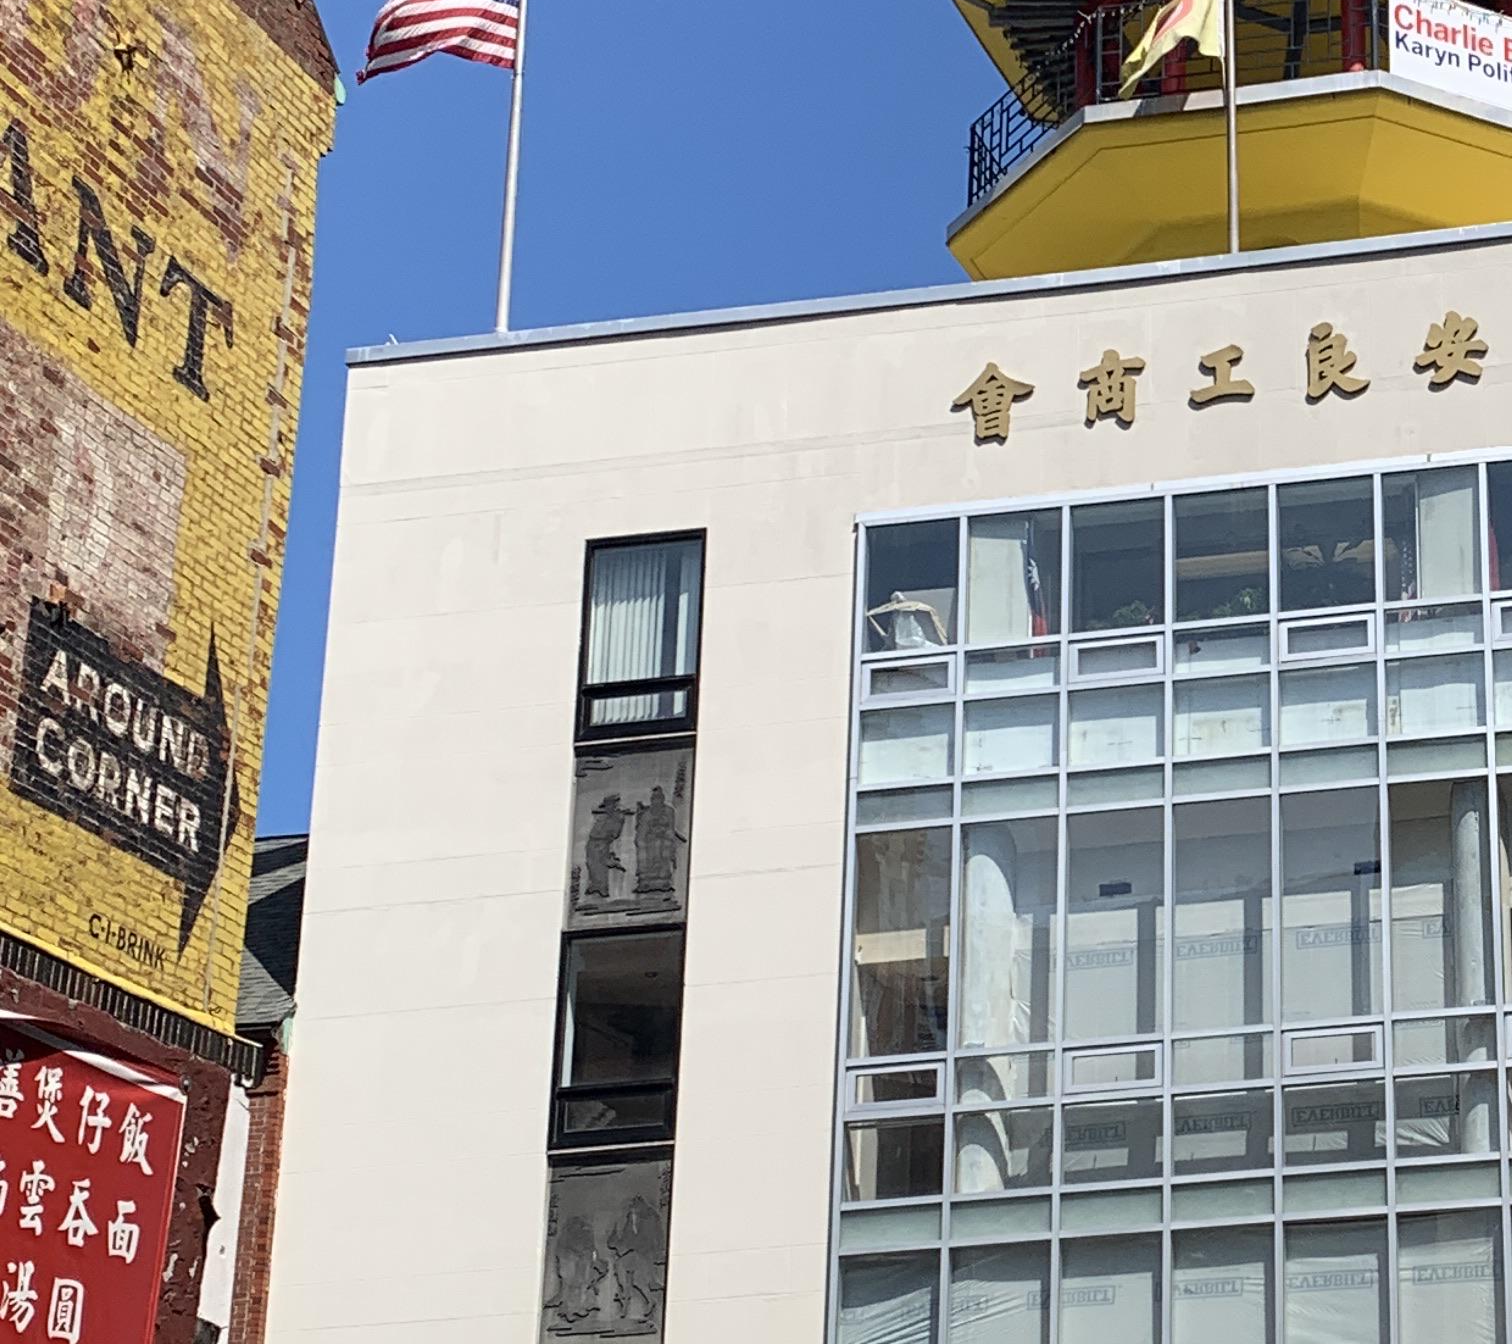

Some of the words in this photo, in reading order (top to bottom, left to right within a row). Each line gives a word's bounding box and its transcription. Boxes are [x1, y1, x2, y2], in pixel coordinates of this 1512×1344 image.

[1393, 4, 1494, 56] Charlie
[1394, 30, 1460, 67] Karyn
[40, 649, 211, 782] AROUND
[36, 718, 202, 853] CORNER
[0, 1159, 140, 1264] 雲吞面
